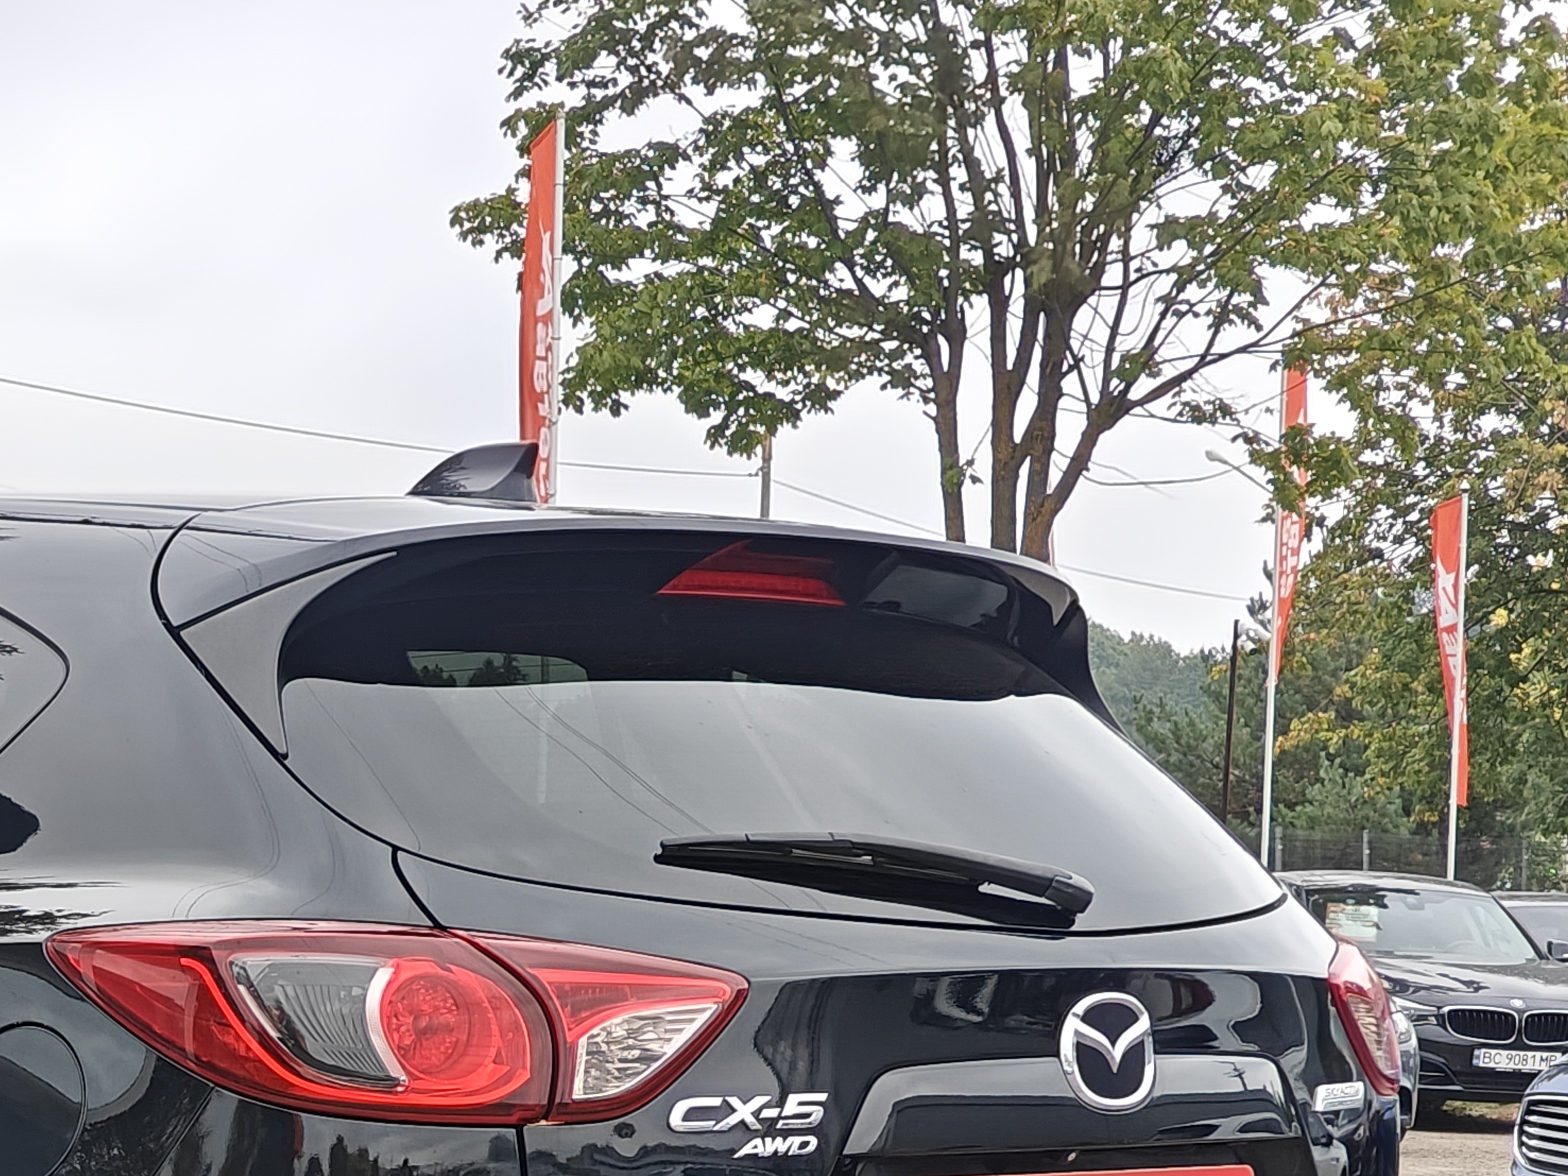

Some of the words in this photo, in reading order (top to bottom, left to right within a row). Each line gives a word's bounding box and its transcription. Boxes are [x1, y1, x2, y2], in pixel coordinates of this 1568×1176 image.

[1482, 1051, 1502, 1065] BC
[1505, 1053, 1536, 1067] 9081
[668, 1092, 829, 1132] CX-5
[732, 1135, 818, 1159] AWD
